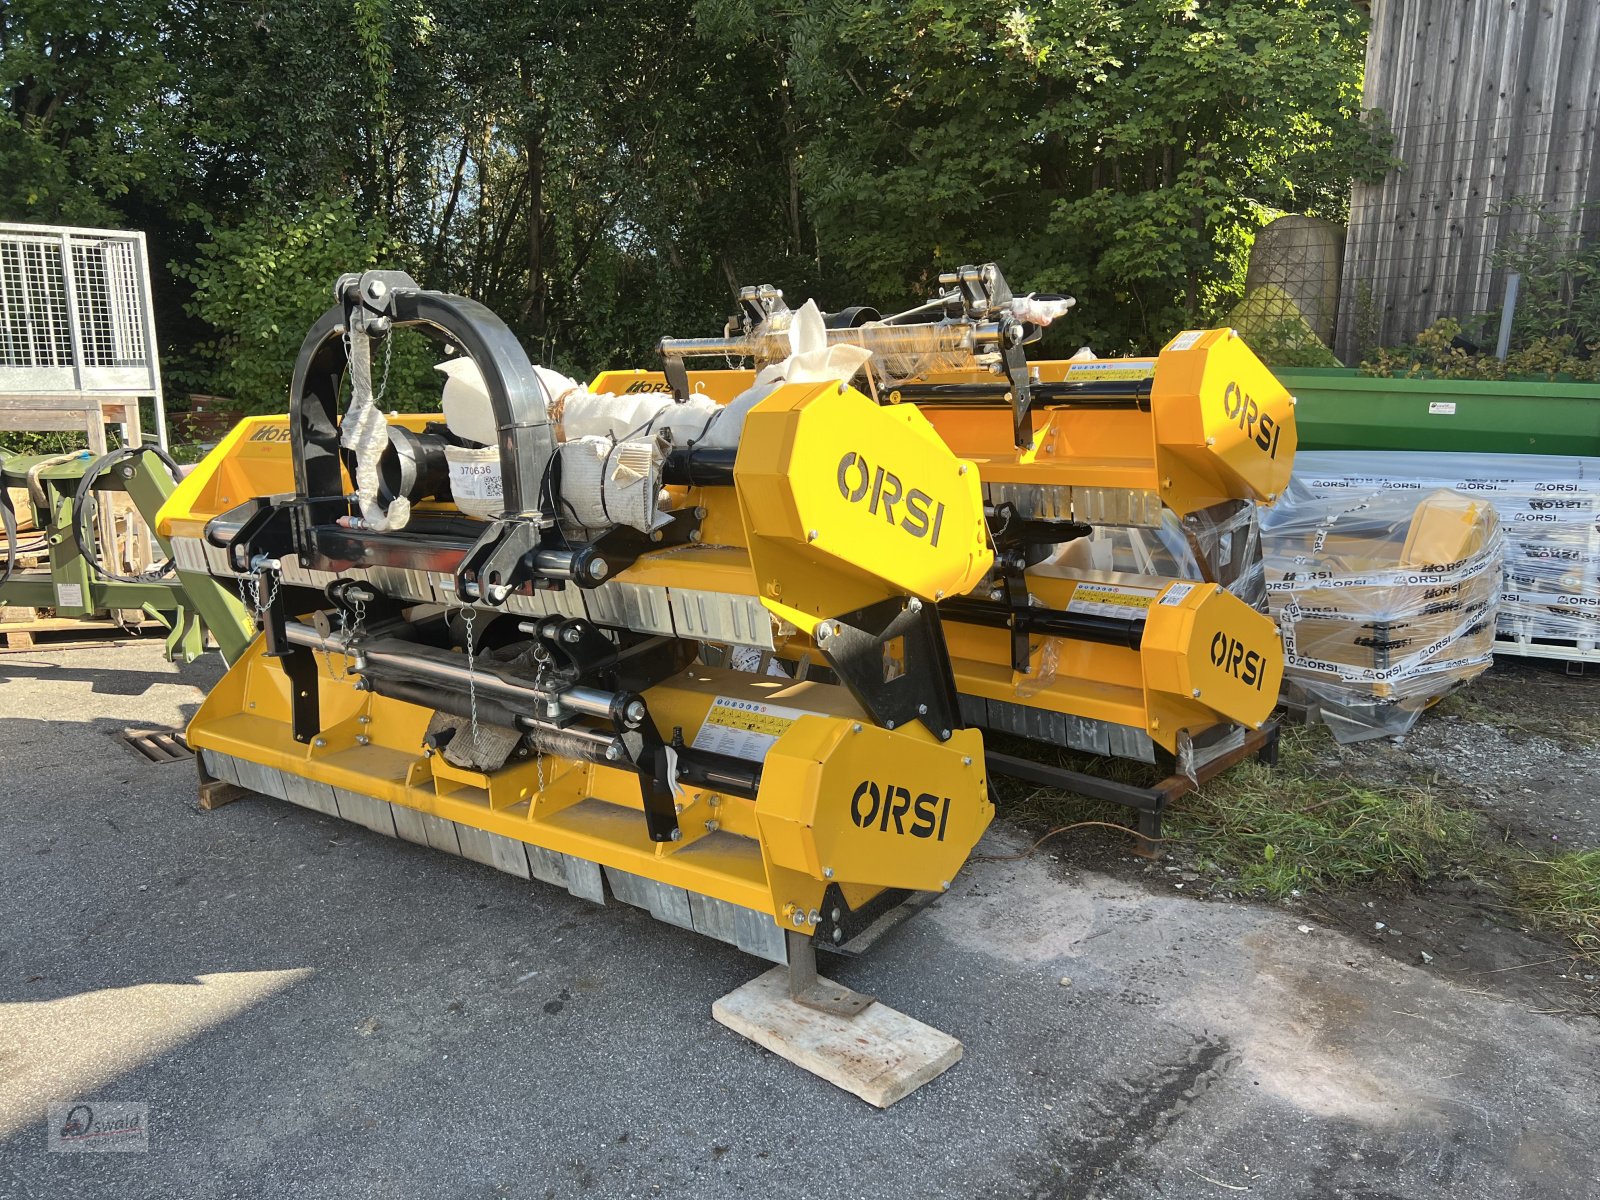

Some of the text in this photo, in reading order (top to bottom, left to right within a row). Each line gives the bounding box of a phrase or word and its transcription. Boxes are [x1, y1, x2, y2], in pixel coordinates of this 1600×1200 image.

[1224, 381, 1281, 460] ORSI
[837, 451, 946, 548] ORSI
[1408, 575, 1442, 584] ORSI
[1285, 636, 1296, 665] ORSI
[1428, 635, 1451, 654] ORSI
[1211, 631, 1267, 691] ORSI
[1307, 660, 1338, 673] ORSI
[1375, 664, 1402, 680] ORSI
[850, 780, 951, 842] ORSI
